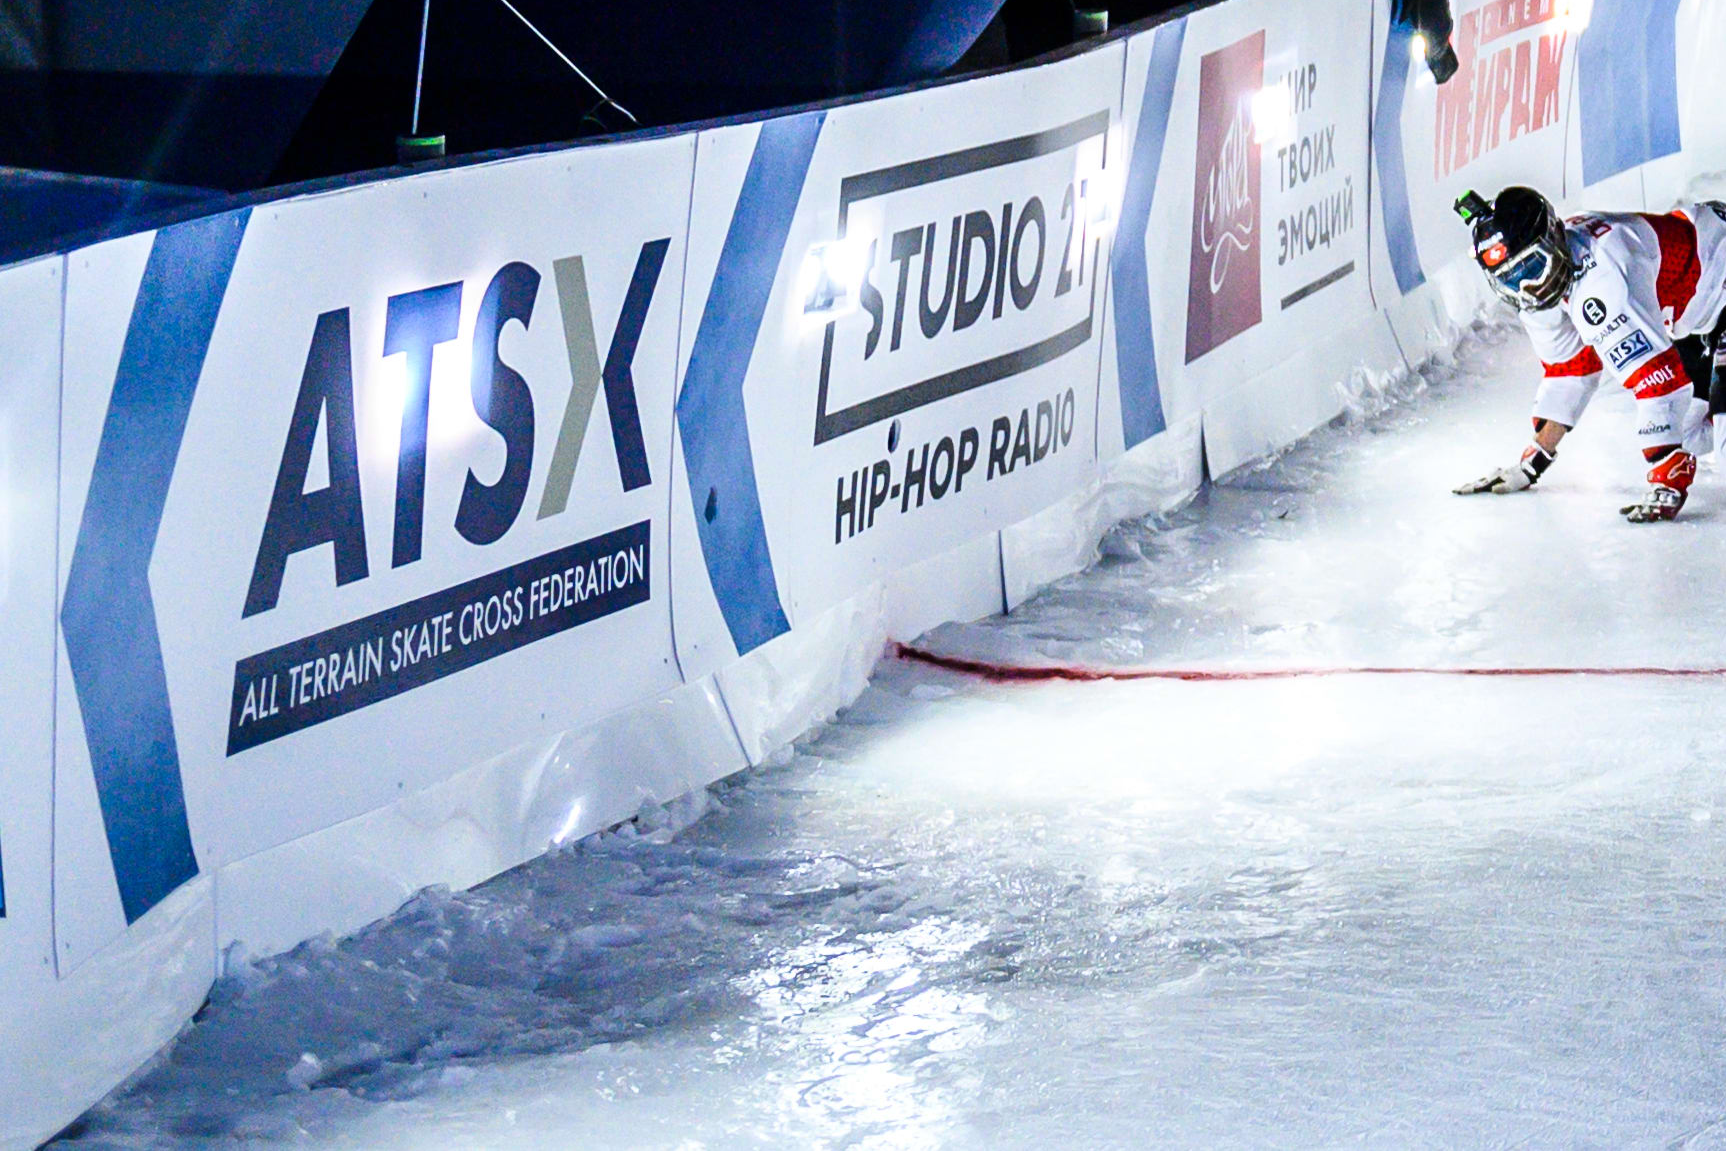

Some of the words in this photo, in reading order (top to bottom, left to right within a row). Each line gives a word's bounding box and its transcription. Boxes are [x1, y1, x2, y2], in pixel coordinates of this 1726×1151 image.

[1277, 175, 1354, 266] ЭМОЦИЙ
[1278, 124, 1336, 193] ТВОИХ
[860, 195, 1047, 360] STUDIO
[1053, 178, 1090, 299] 21
[242, 237, 671, 620] ATSX
[834, 426, 980, 544] HIP-HOP
[986, 387, 1075, 482] RADIO
[238, 681, 280, 727] ALL
[287, 637, 383, 705] TERRAIN
[389, 611, 455, 672] SKATE
[459, 586, 524, 645] CROSS
[529, 545, 645, 620] FEDERATION
